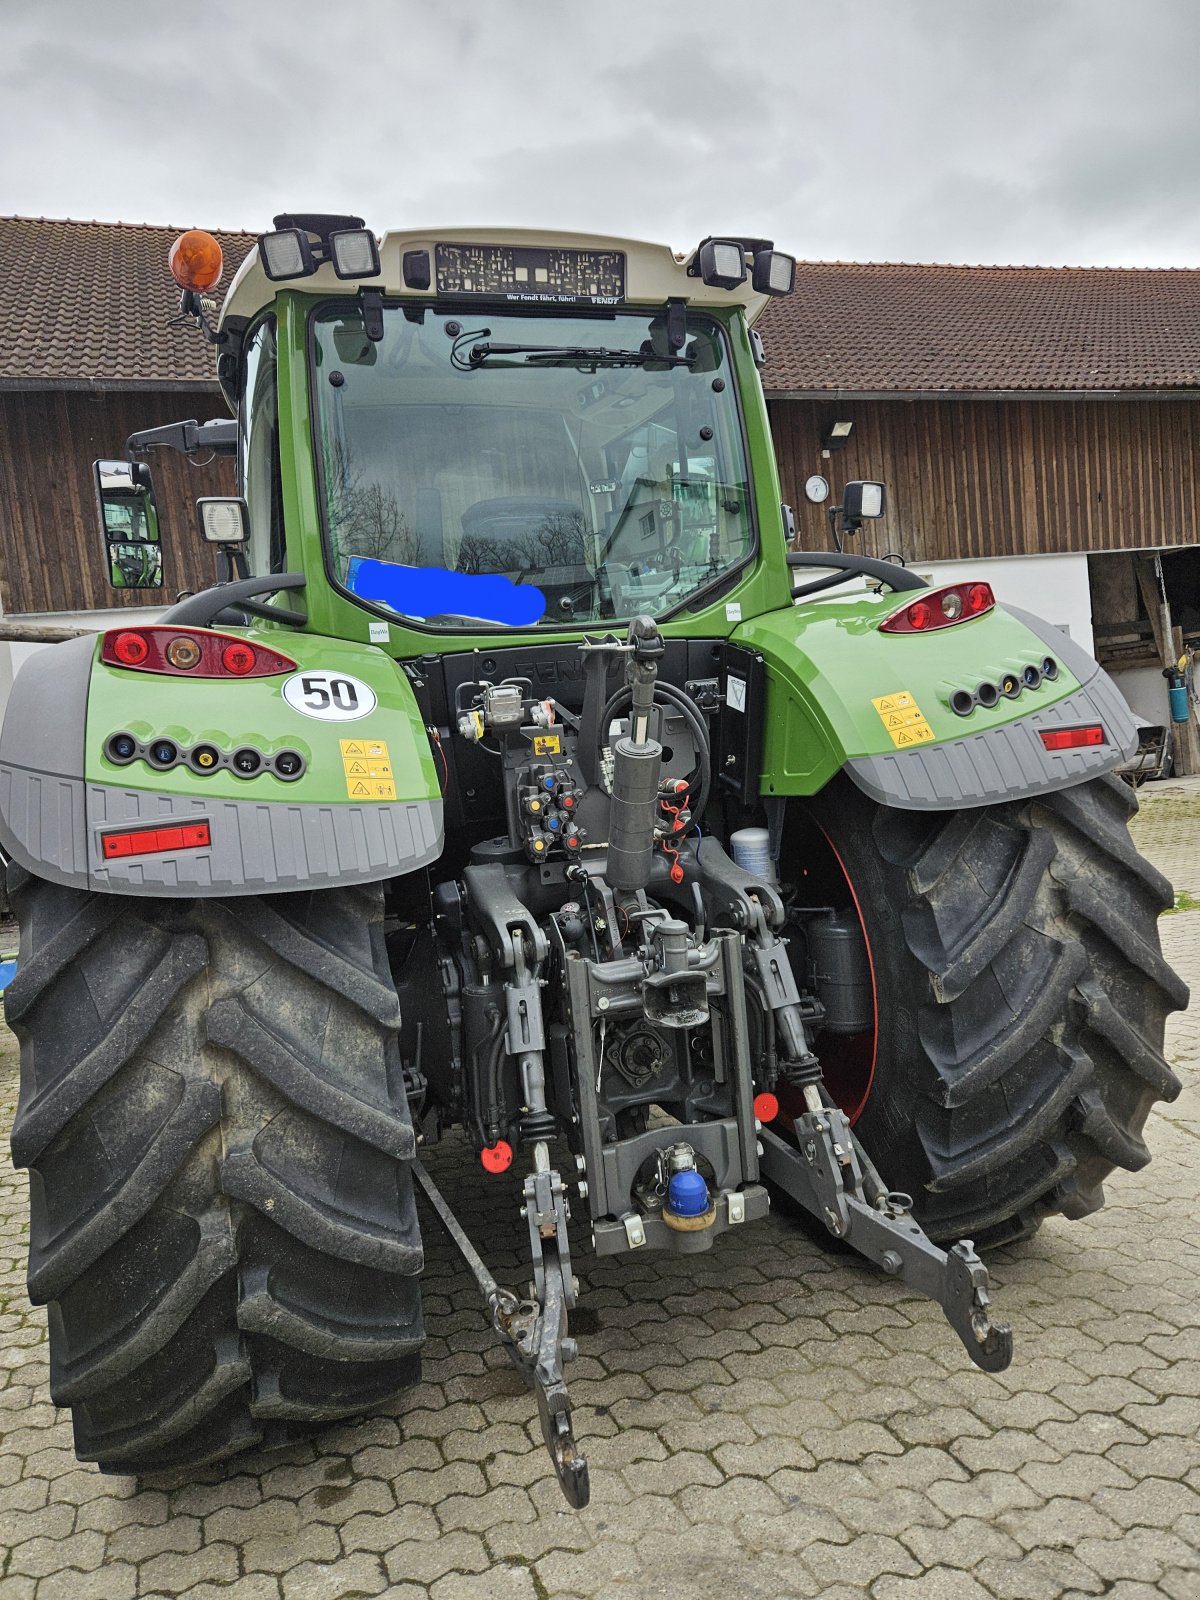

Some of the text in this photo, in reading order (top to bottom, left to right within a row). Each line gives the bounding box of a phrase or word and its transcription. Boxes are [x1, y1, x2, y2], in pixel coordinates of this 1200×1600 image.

[539, 294, 557, 302] fährt,
[591, 296, 620, 305] FENDT
[301, 678, 359, 711] 50
